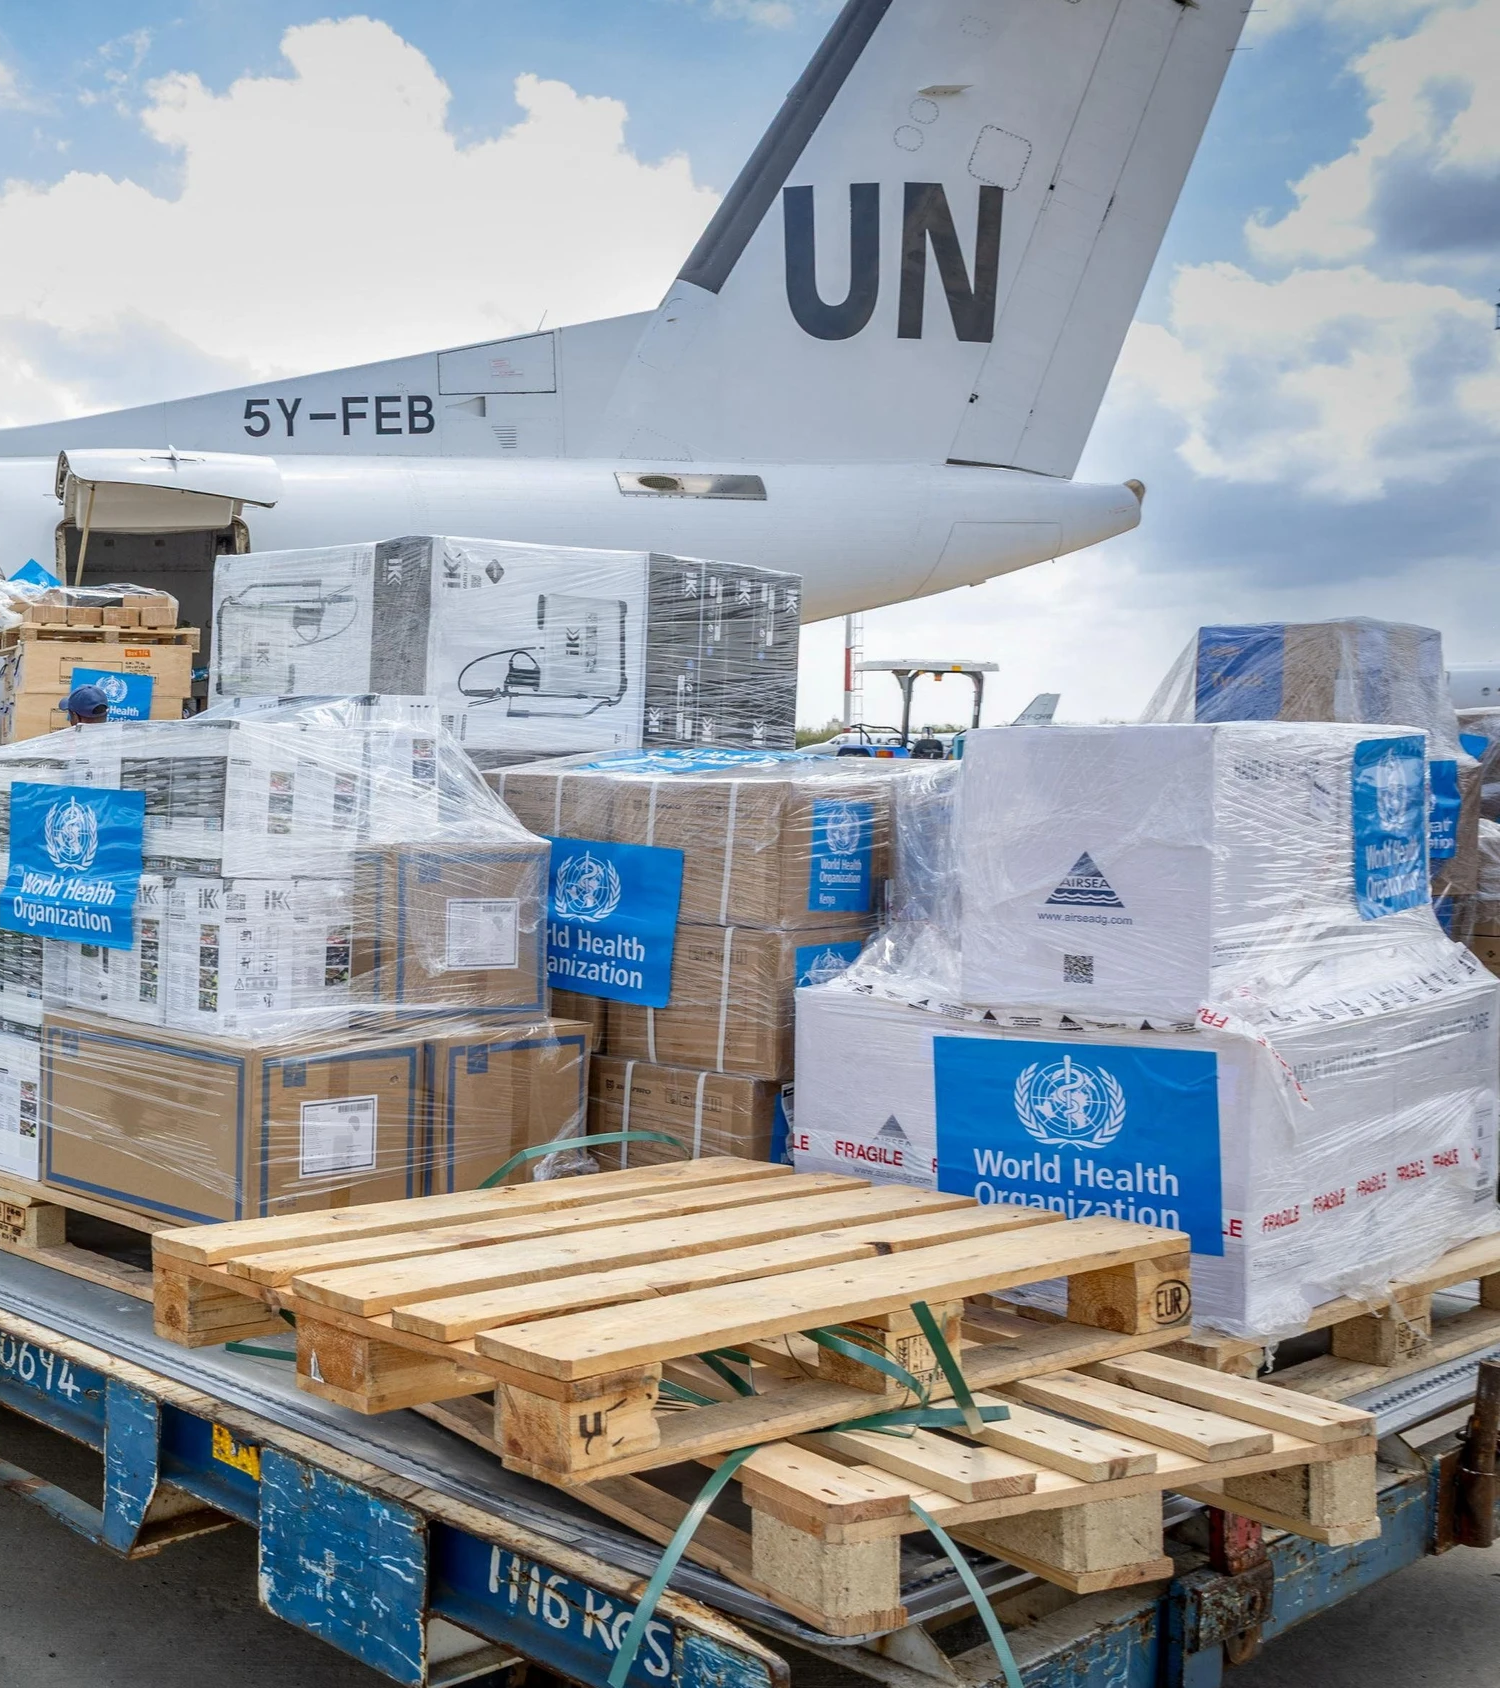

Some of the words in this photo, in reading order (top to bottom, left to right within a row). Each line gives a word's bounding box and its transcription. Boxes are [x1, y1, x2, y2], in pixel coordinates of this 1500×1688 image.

[783, 182, 1004, 343] UN
[244, 395, 435, 437] 5Y-FEB
[109, 705, 139, 717] Health
[819, 871, 861, 886] Organization
[820, 858, 840, 870] World
[841, 858, 862, 871] Health
[20, 872, 64, 897] World
[63, 878, 116, 906] Health
[1059, 878, 1111, 889] AIRSEA
[13, 896, 112, 933] Organization
[819, 893, 836, 907] Kenya
[1037, 913, 1133, 926] www.airseadg.com
[547, 923, 570, 949] rld
[577, 929, 645, 962] Health
[547, 954, 642, 989] anization
[835, 1140, 903, 1167] FRAGILE
[973, 1148, 1061, 1184] World
[1074, 1158, 1179, 1197] Health
[1312, 1187, 1346, 1215] FRAGILE
[1262, 1204, 1301, 1234] FRAGILE
[1156, 1285, 1183, 1318] EUR
[583, 1589, 671, 1678] KGS
